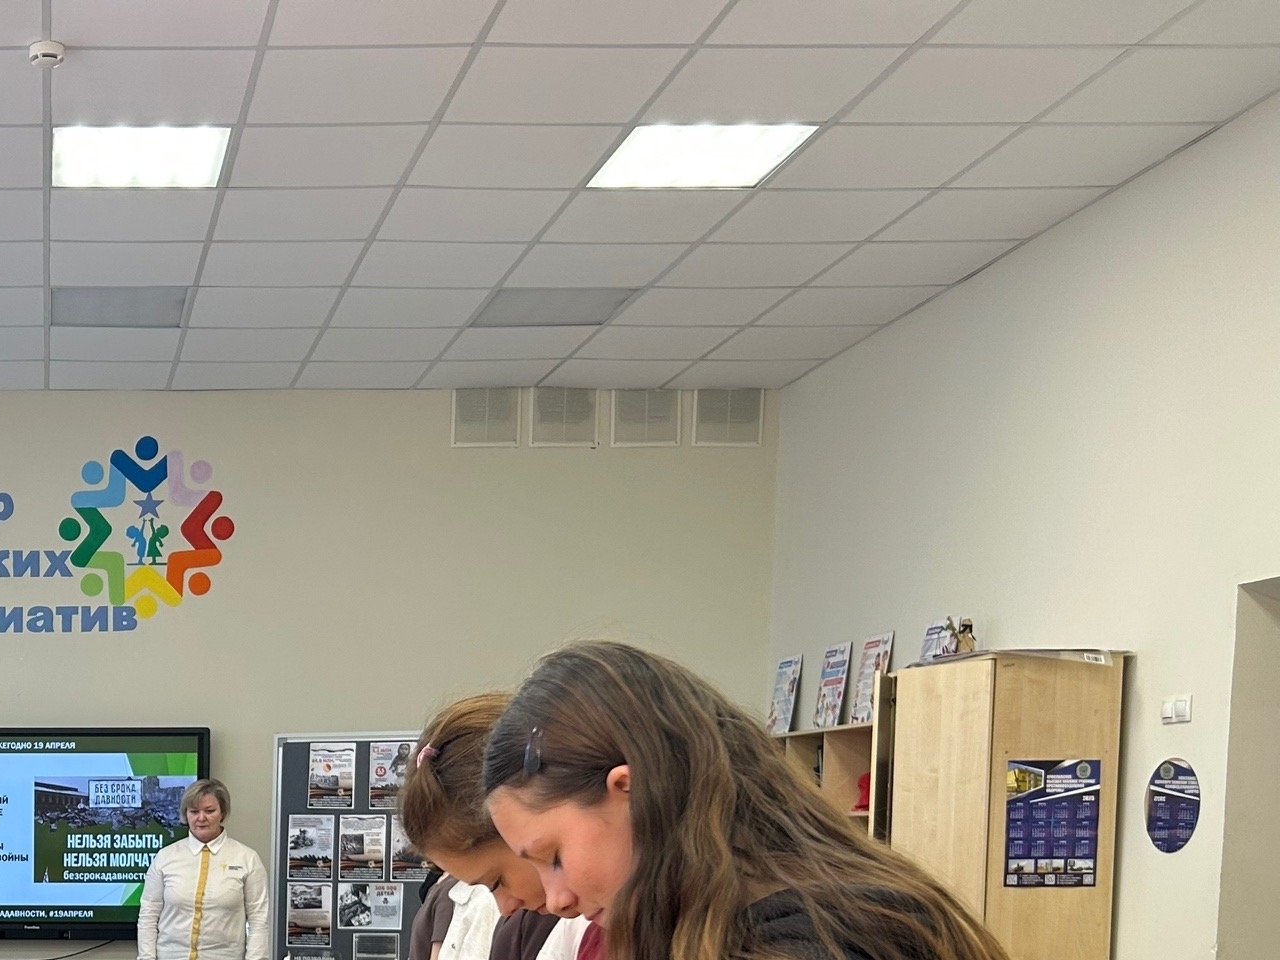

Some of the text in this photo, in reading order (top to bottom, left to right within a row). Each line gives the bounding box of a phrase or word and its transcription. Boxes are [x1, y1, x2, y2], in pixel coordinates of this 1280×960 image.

[33, 741, 44, 749] 19
[45, 741, 76, 750] АПРЕЛЯ
[94, 783, 136, 793] БЕЗ СРОКА
[94, 794, 136, 805] ДАВНОСТИ
[67, 834, 163, 849] НЕЛЬЗЯ ЗАБЫТЬ!
[63, 853, 156, 867] НЕЛЬЗЯ МОЛЧАТ
[49, 910, 94, 918] #19АПРЕЛЯ
